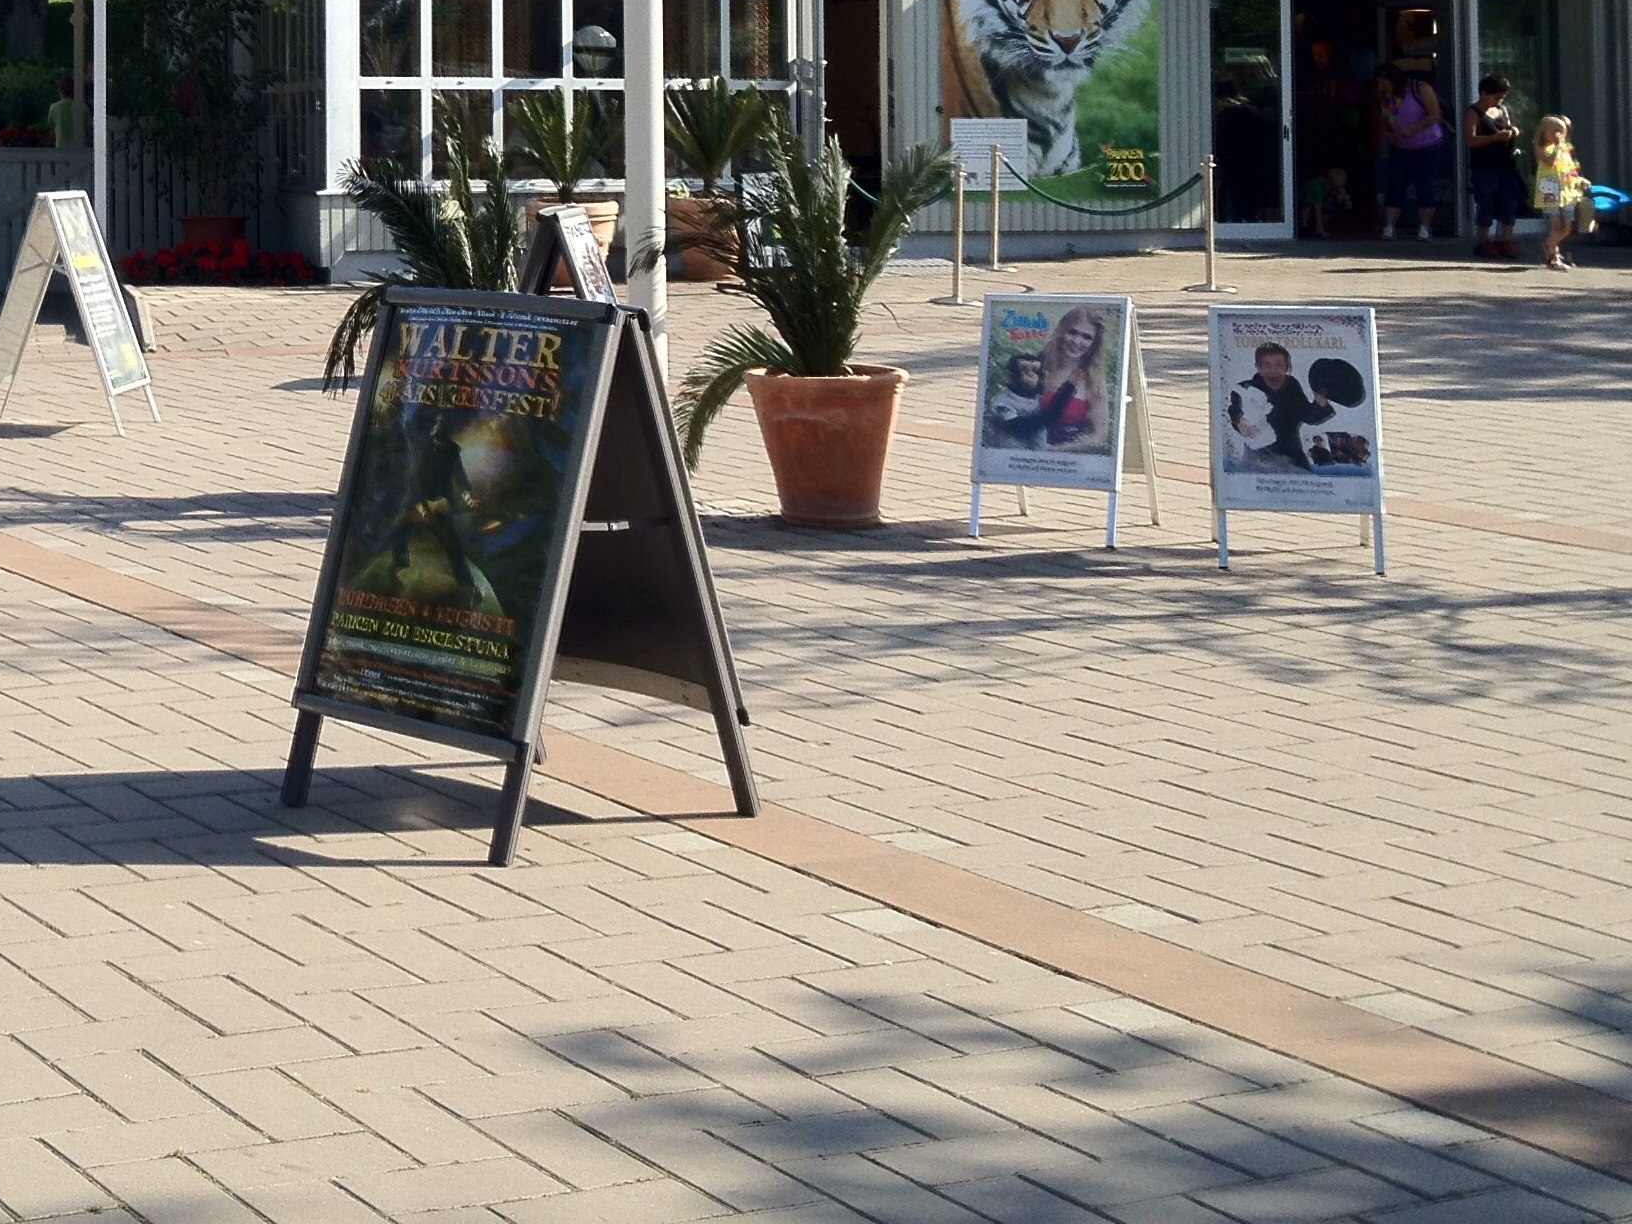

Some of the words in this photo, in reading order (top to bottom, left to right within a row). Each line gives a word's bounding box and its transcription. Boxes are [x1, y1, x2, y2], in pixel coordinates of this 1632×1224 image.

[1106, 162, 1145, 181] ZOO
[399, 322, 563, 370] WALTER
[332, 611, 379, 634] PARKEN
[413, 627, 510, 659] ESKILSTUNA
